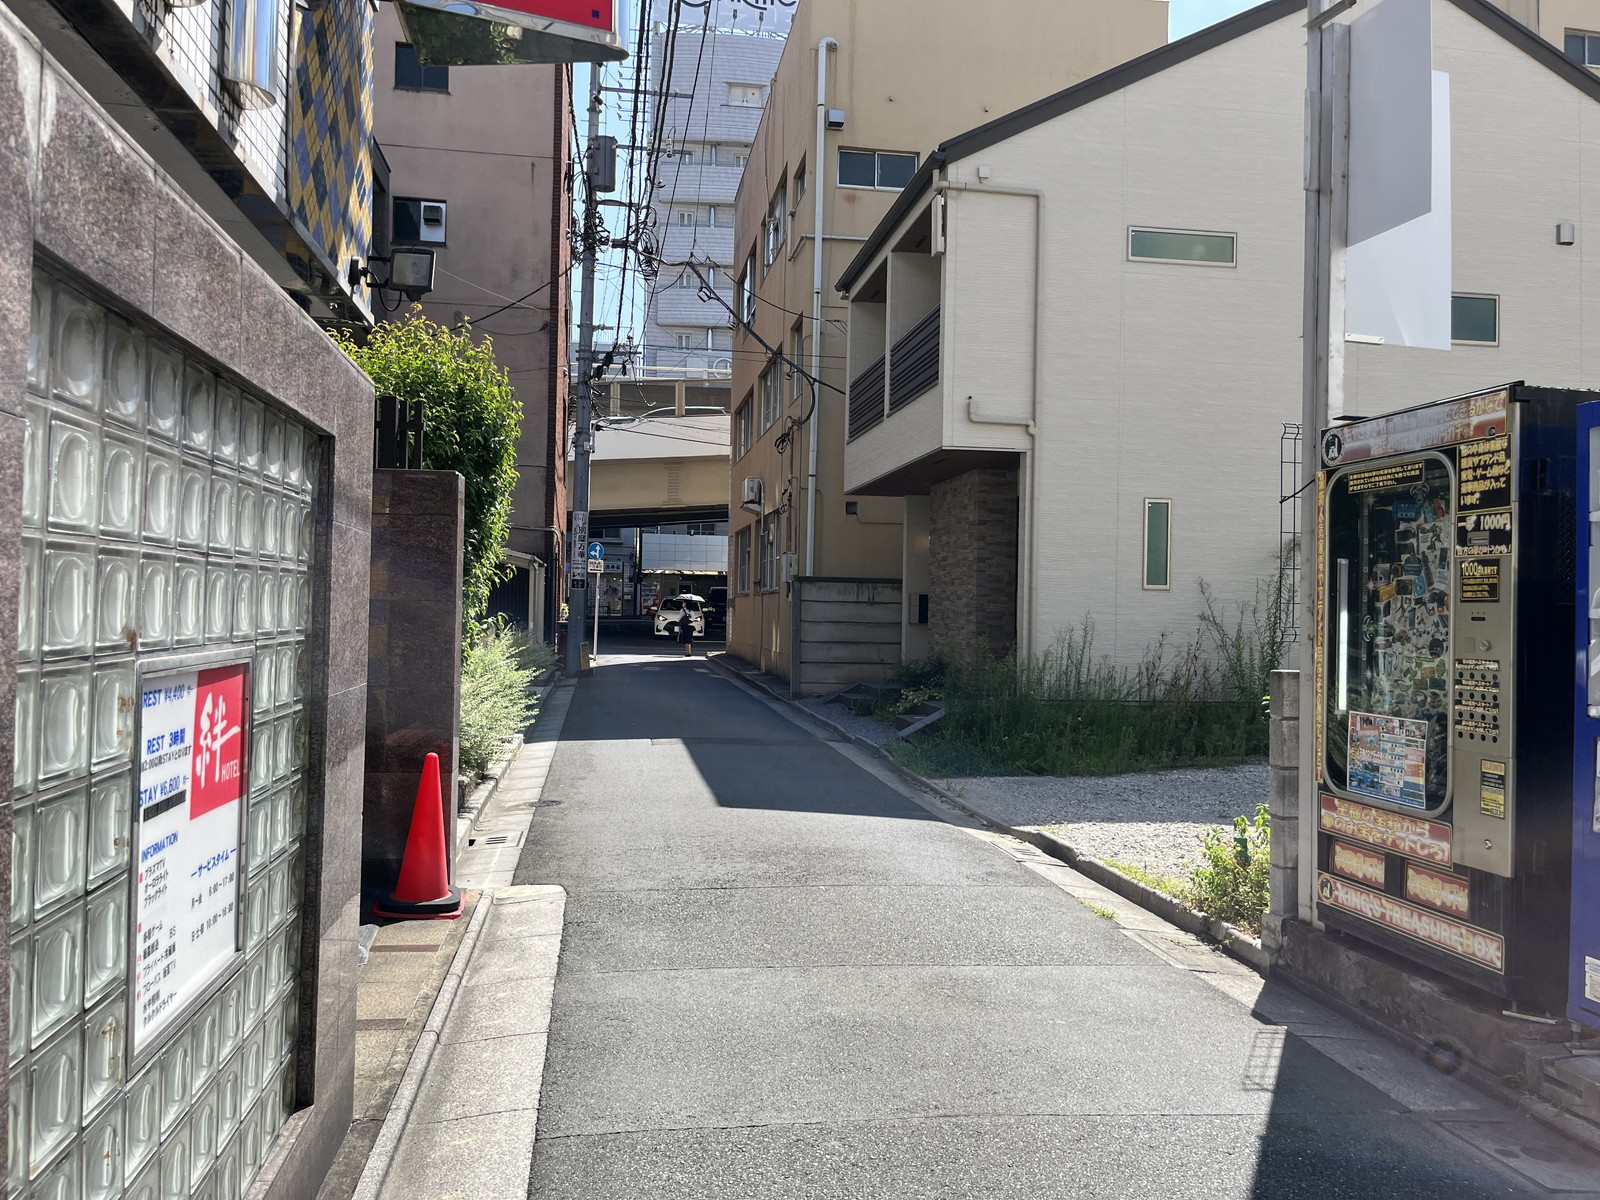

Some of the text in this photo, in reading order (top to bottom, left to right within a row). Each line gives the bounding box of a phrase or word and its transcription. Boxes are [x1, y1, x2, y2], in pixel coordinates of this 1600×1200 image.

[1480, 513, 1511, 531] 1000円
[142, 689, 162, 707] REST
[147, 728, 186, 755] REST 3時間
[196, 692, 242, 789] 絆
[221, 759, 240, 782] HOTEL
[139, 783, 158, 808] STAY
[1335, 799, 1431, 838] 王様の宝箱から
[142, 831, 178, 863] INFORMATION
[1381, 897, 1463, 951] TREASURE
[1463, 927, 1503, 966] BOX
